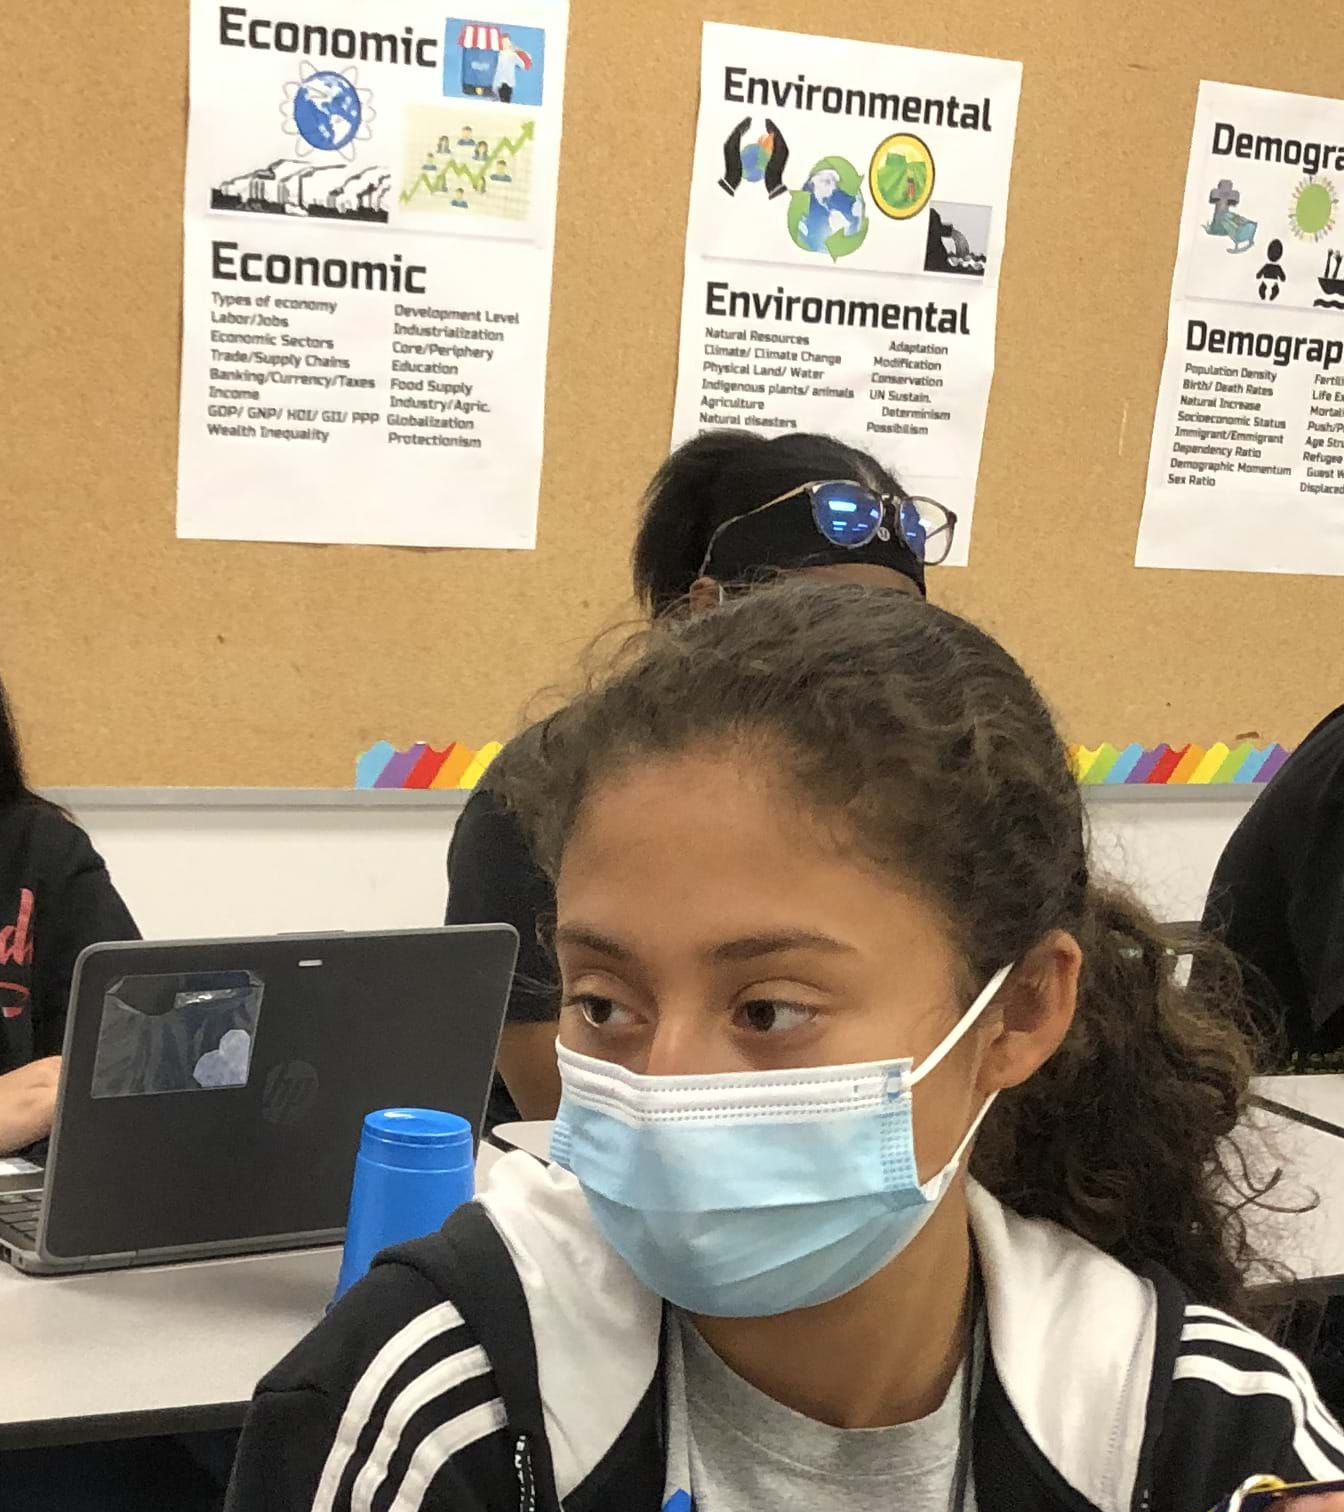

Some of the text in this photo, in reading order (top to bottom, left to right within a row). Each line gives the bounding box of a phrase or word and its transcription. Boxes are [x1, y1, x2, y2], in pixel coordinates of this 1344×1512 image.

[220, 6, 437, 67] Economic
[725, 67, 991, 131] Environmental
[212, 241, 426, 294] Economic
[212, 291, 337, 314] Types of economy
[706, 282, 970, 335] Environmental
[211, 311, 289, 328] Labor/Jobs
[394, 304, 519, 324] Development Level
[211, 330, 334, 349] Economic Sectors
[394, 323, 504, 341] Industrialization
[705, 327, 809, 345] Natural Resources
[392, 341, 493, 361] Core/Periphery
[705, 344, 841, 366] Climate/ Climate Change
[889, 341, 948, 355] Adaptation
[210, 349, 350, 372] Trade/Supply Chains
[392, 360, 458, 374] Education
[873, 356, 941, 371] Modification
[209, 368, 375, 388] Banking/Currency/Taxes
[703, 361, 824, 379] Physical Land/ Water
[390, 378, 473, 396] Food Supply
[702, 378, 854, 398] Indigenous plants/ animals
[871, 372, 943, 387] Conservation
[209, 386, 260, 400] Income
[870, 390, 931, 403] UN Sustain.
[390, 395, 490, 414] Industry/Agric.
[700, 395, 764, 413] Agriculture
[882, 406, 951, 420] Determinism
[352, 412, 380, 424] PPP
[387, 414, 474, 429] Globalization
[700, 412, 797, 429] Natural disasters
[207, 424, 329, 443] Wealth Inequality
[867, 422, 928, 434] Possibilism
[388, 432, 481, 448] Protectionism
